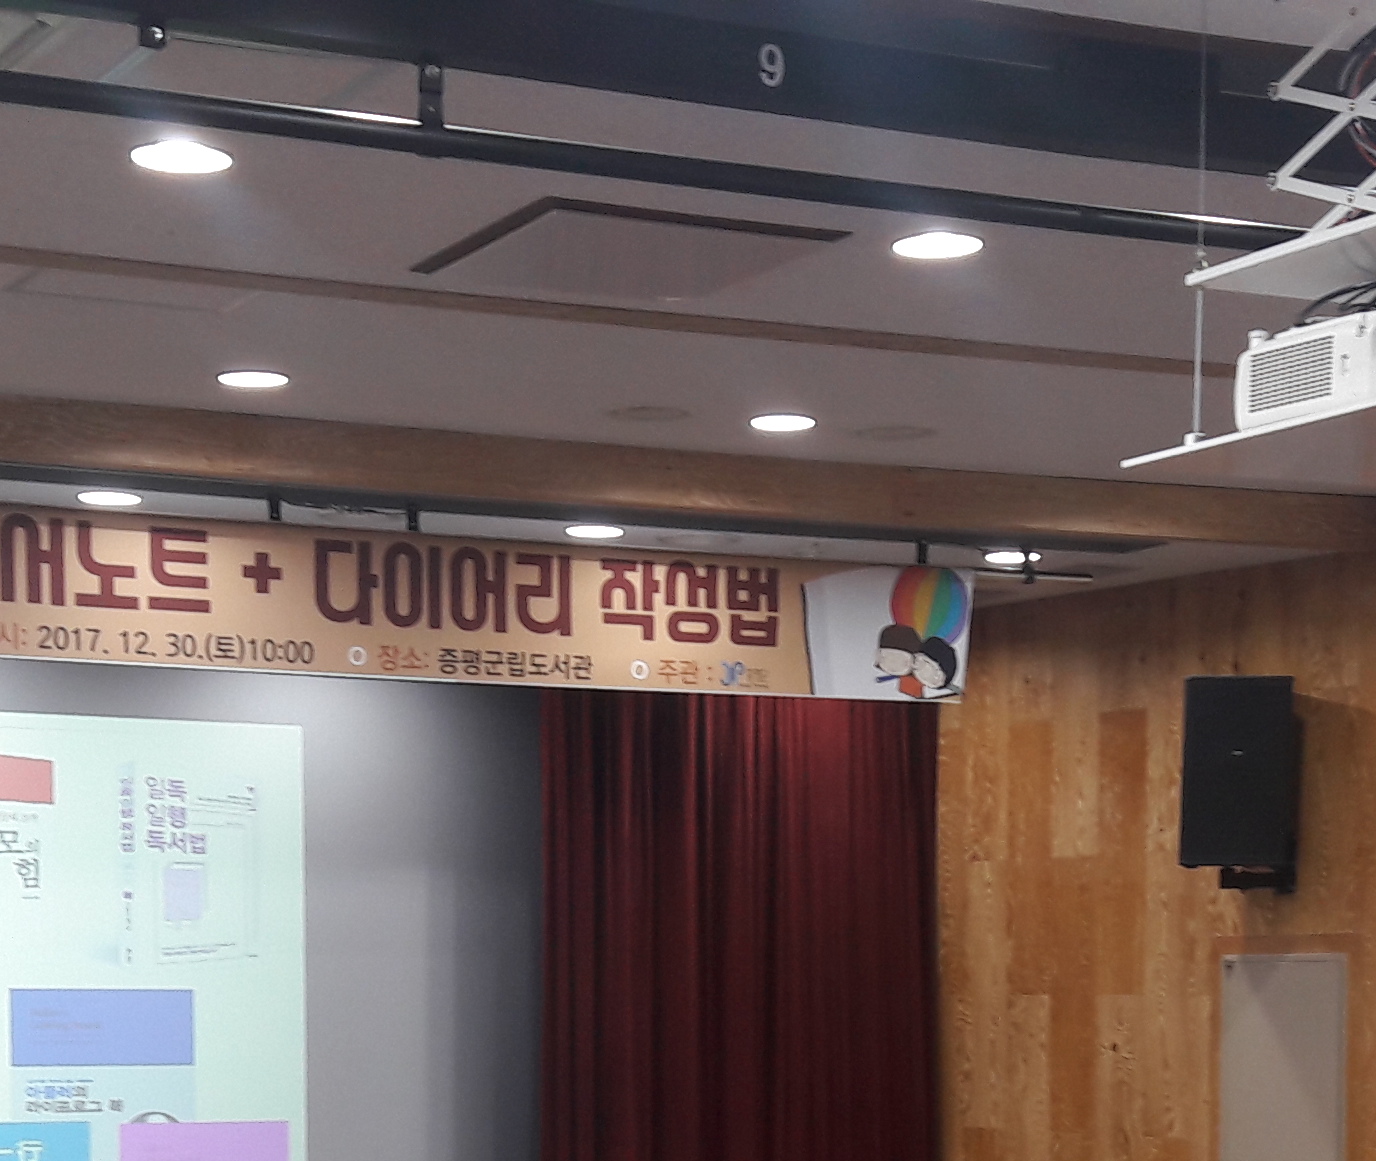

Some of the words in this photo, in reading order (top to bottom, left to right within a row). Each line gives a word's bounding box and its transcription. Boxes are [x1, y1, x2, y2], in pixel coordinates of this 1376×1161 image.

[758, 42, 785, 87] 9
[242, 552, 284, 594] +
[315, 538, 572, 636] 다이어리
[600, 559, 779, 647] 작성법
[37, 625, 110, 654] 2017.
[119, 630, 158, 657] 12.
[437, 647, 594, 682] 증평군립도서관
